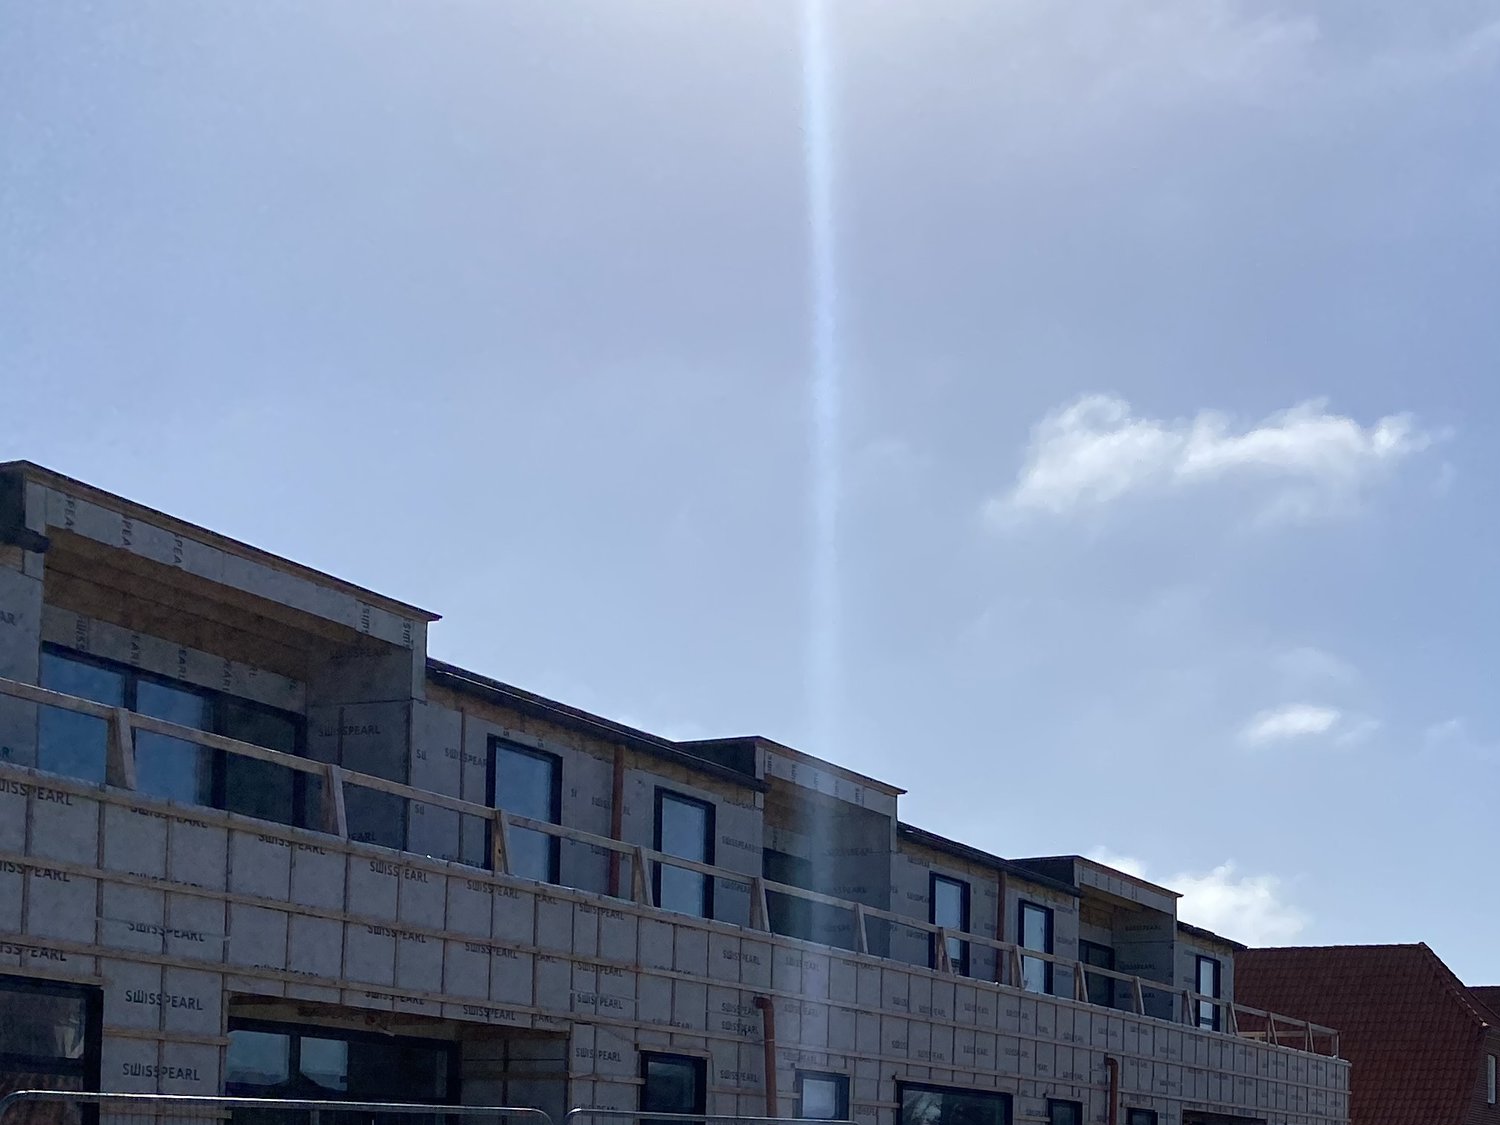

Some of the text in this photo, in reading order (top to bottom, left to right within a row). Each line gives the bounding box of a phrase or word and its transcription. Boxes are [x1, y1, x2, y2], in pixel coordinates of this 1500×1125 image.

[258, 834, 325, 855] SWISSEARL
[370, 861, 428, 883] SWISSEARL
[466, 879, 519, 899] SWISSEARL
[579, 903, 624, 920] SWISPEARL
[367, 925, 426, 943] SWISSEARL
[465, 941, 518, 959] SWISSEARL
[577, 961, 622, 977] SWISPEARL
[365, 991, 424, 1005] SWISSEARL
[577, 993, 623, 1010] SWISPEARL
[575, 1048, 621, 1062] SWISPEARL
